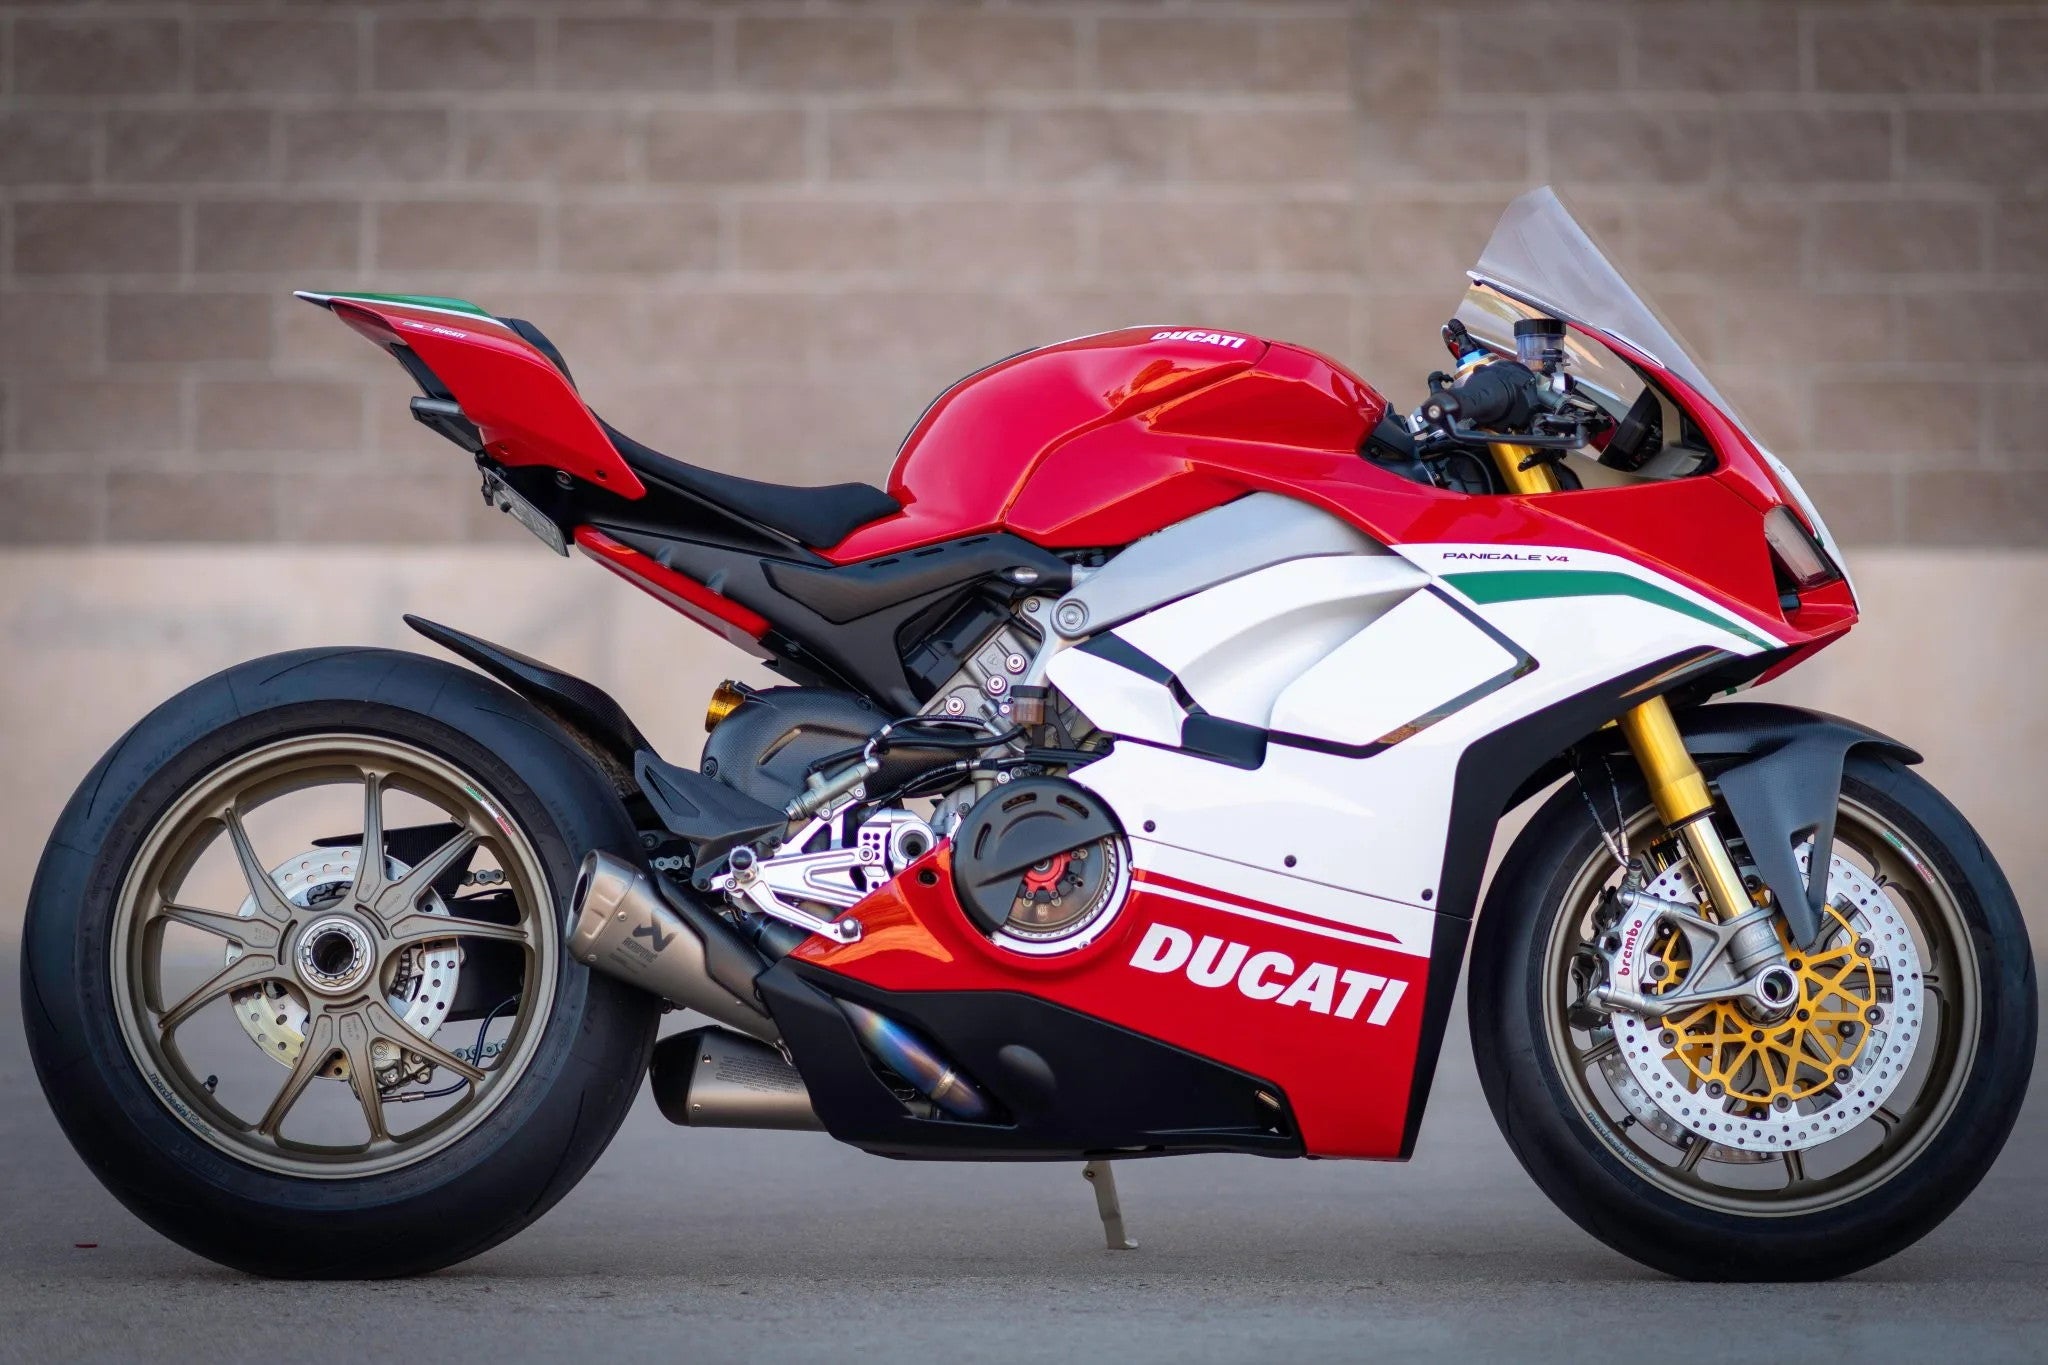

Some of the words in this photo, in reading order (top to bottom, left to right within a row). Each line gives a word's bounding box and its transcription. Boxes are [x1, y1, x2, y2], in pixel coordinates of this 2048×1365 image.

[1150, 331, 1246, 349] DUCATI
[1442, 552, 1542, 561] PANIGALE
[1546, 554, 1569, 563] V4
[1617, 919, 1643, 976] brembo
[1128, 922, 1409, 1026] DUCATI
